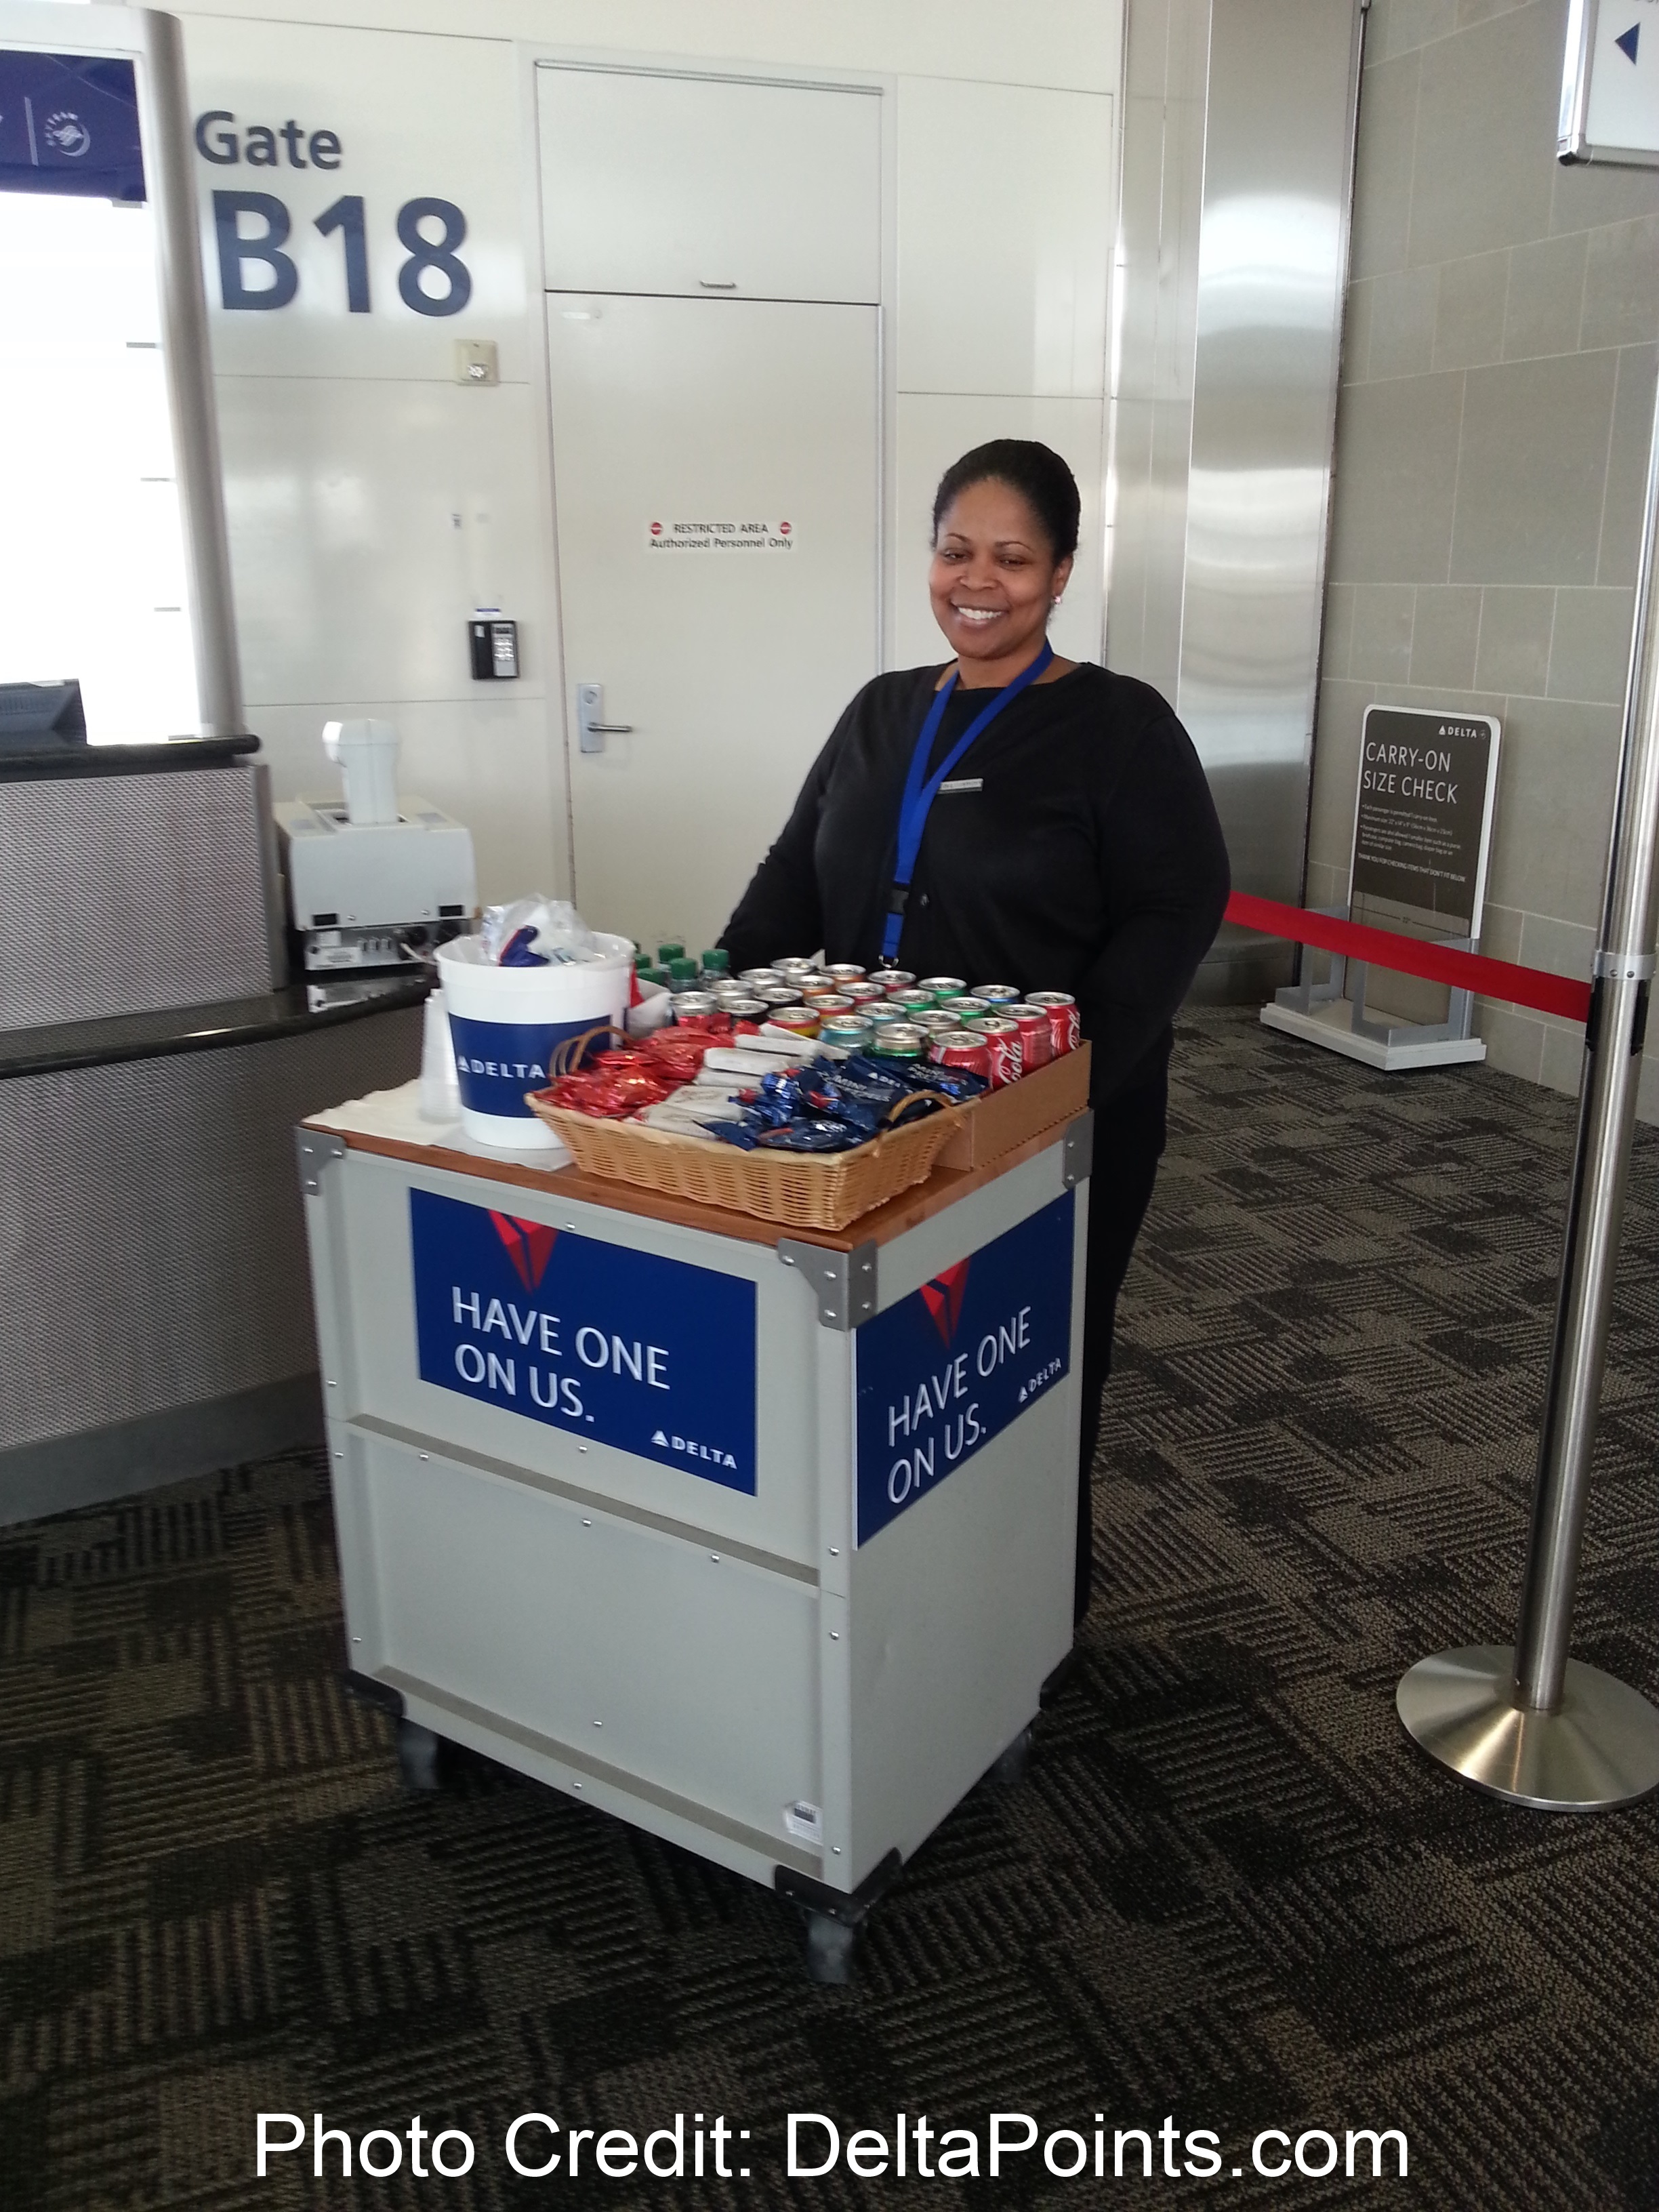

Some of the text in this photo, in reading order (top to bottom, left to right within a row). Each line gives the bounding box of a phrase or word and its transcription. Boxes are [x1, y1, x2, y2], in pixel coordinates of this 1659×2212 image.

[195, 110, 342, 169] Gate
[211, 190, 472, 316] B18
[650, 537, 793, 550] Authorized Personnel Only
[674, 523, 769, 534] RESTRICTED AREA
[1448, 726, 1477, 739] DELTA
[1366, 742, 1451, 773] CARRY-ON
[1363, 770, 1458, 804] SIZE CHECK
[471, 1061, 546, 1080] DELTA
[451, 1286, 671, 1390] HAVE ONE
[454, 1343, 595, 1423] ON US.
[888, 1305, 1031, 1447] HAVE ONE
[1028, 1357, 1062, 1393] DELTA
[671, 1435, 737, 1470] DELTA
[887, 1403, 987, 1504] ON US.
